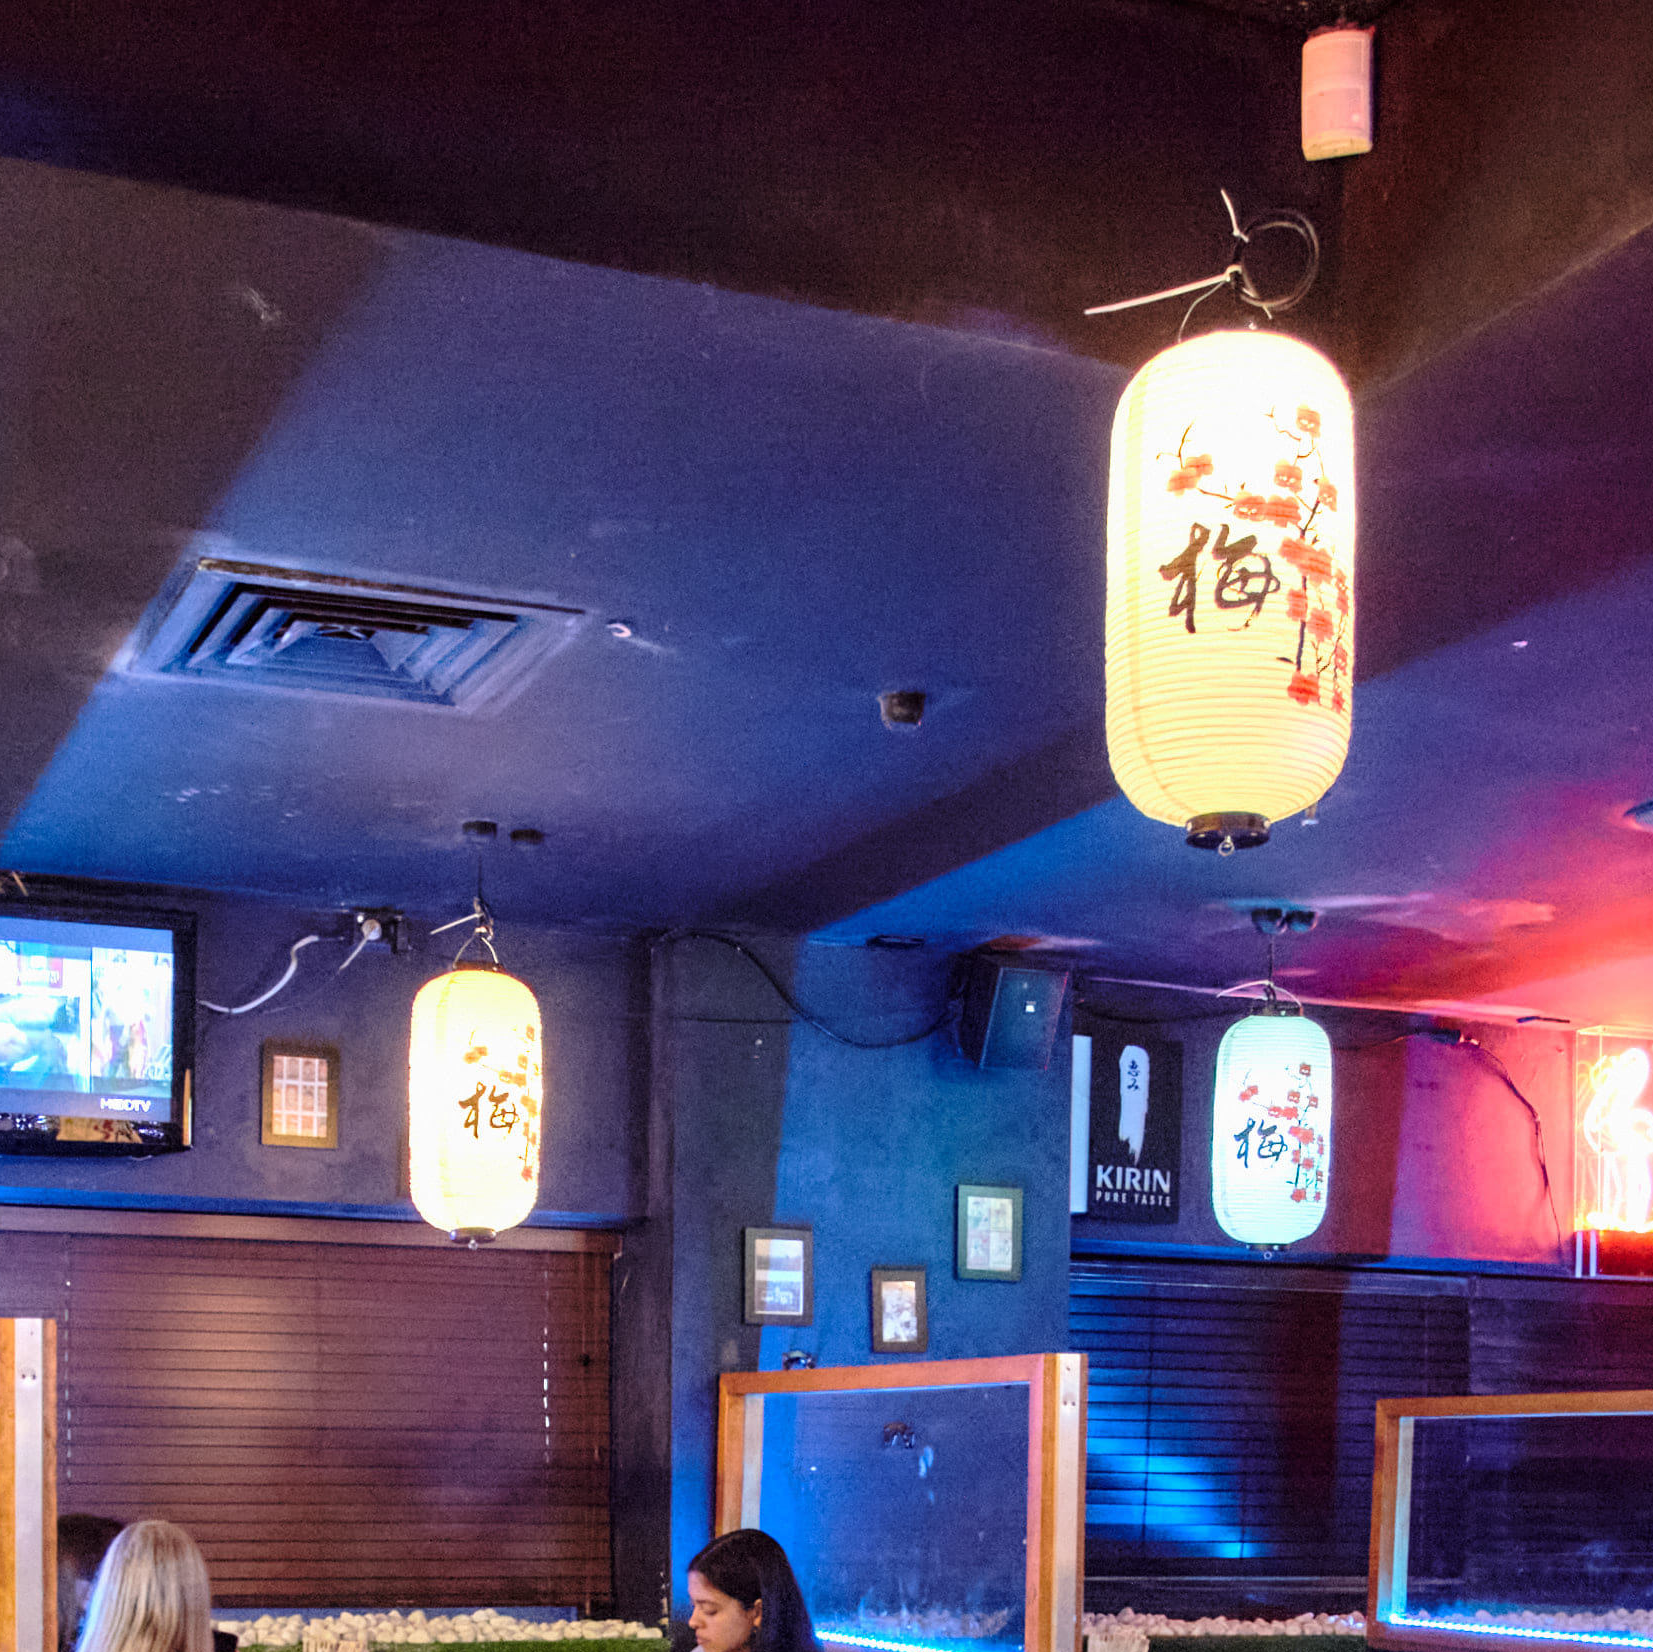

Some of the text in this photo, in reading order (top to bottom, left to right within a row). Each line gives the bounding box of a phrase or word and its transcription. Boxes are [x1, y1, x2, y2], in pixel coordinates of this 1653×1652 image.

[1157, 522, 1280, 634] 梅
[1233, 1117, 1289, 1169] 梅
[1096, 1164, 1171, 1194] KIRIN
[1096, 1190, 1171, 1207] PURE TASTE
